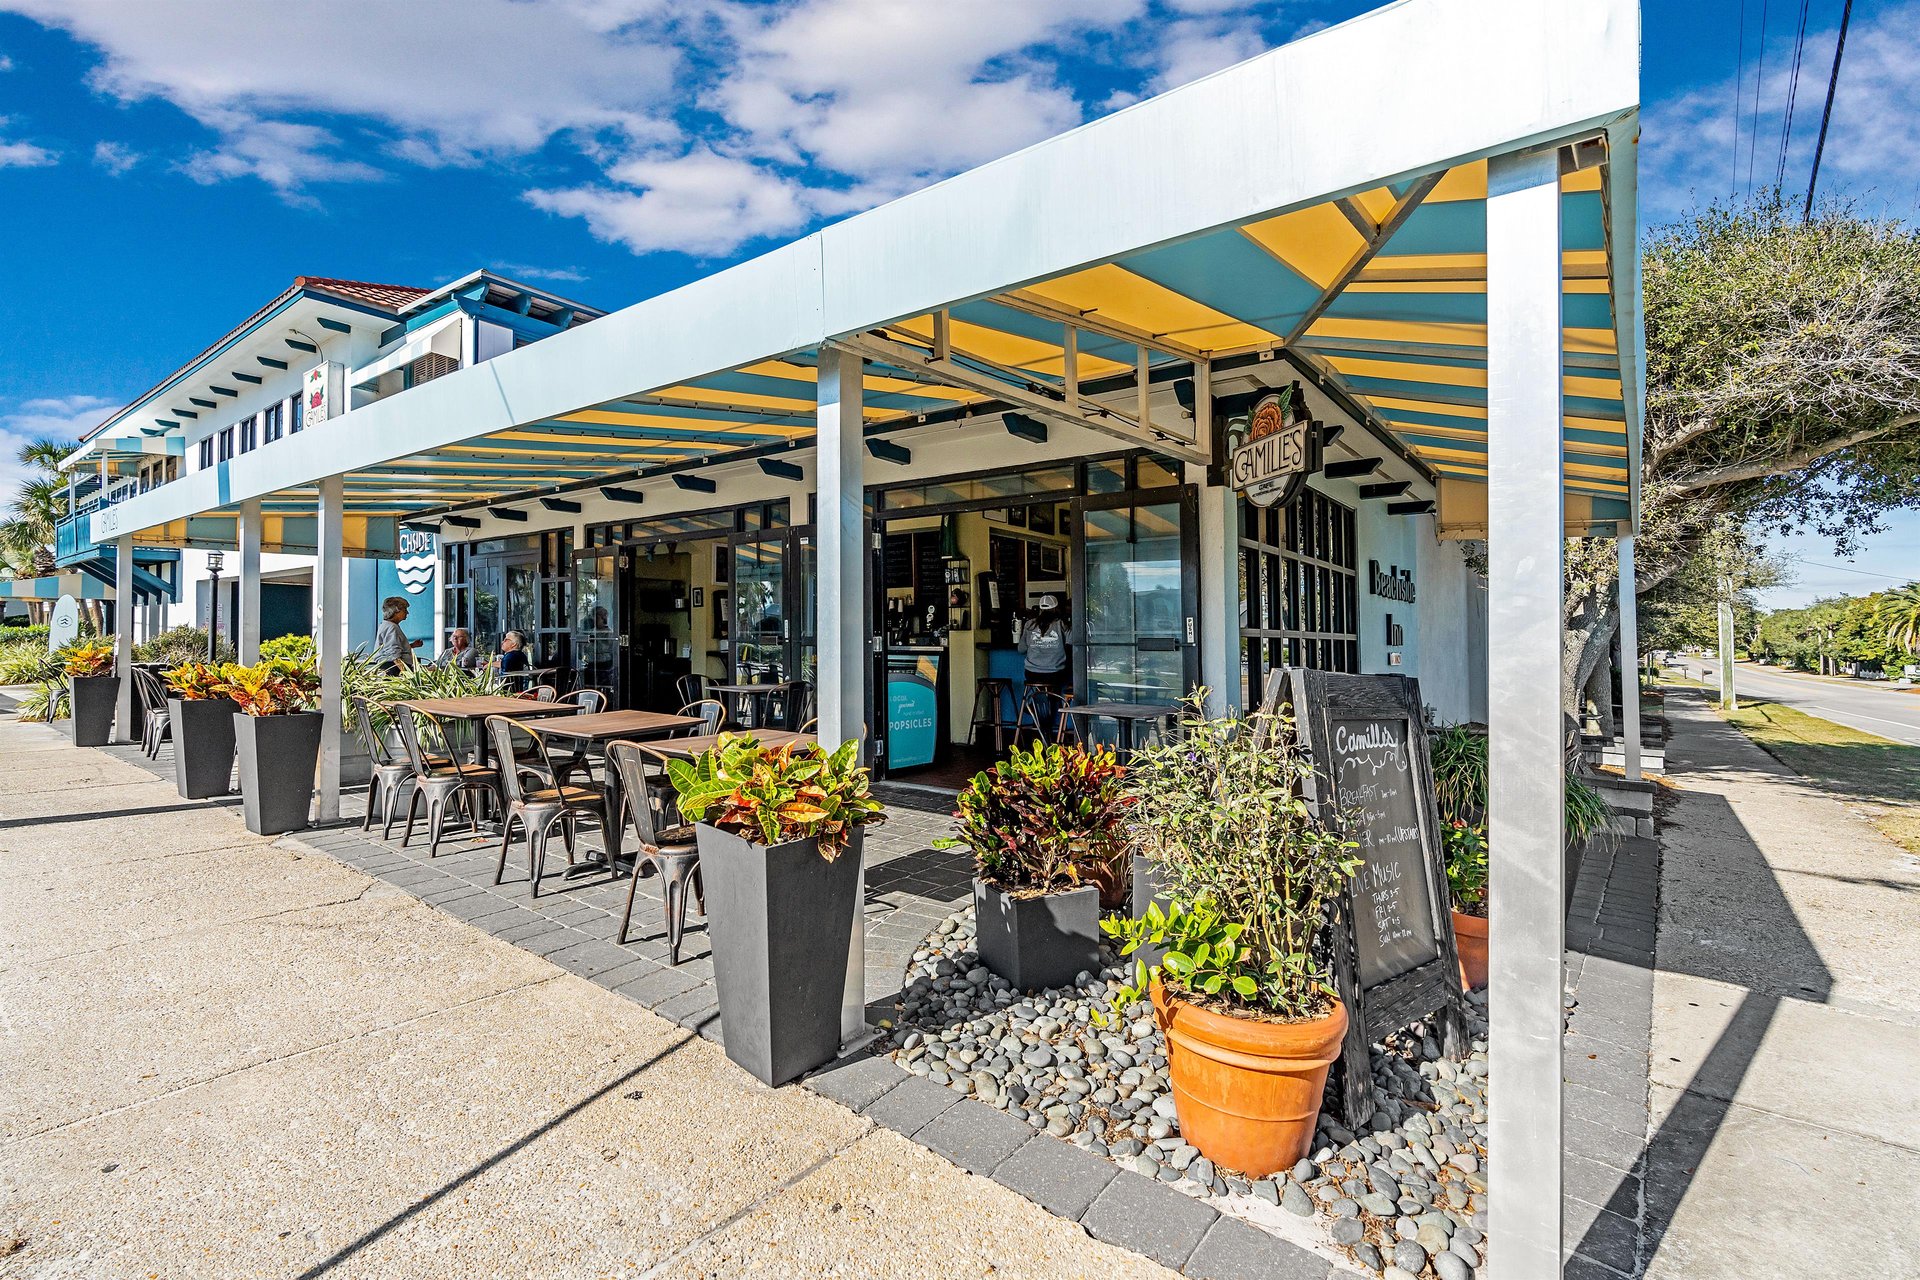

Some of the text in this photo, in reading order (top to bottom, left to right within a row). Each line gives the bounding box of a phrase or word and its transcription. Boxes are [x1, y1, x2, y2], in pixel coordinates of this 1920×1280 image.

[1235, 429, 1302, 482] CAMILLE'S
[1369, 560, 1416, 604] Beachside
[1386, 613, 1403, 646] Inn
[888, 718, 932, 731] POPSICLES
[1372, 861, 1401, 888] MUSIC
[1375, 904, 1387, 919] FRI
[1378, 916, 1391, 933] SAT
[1379, 931, 1391, 948] SUN
